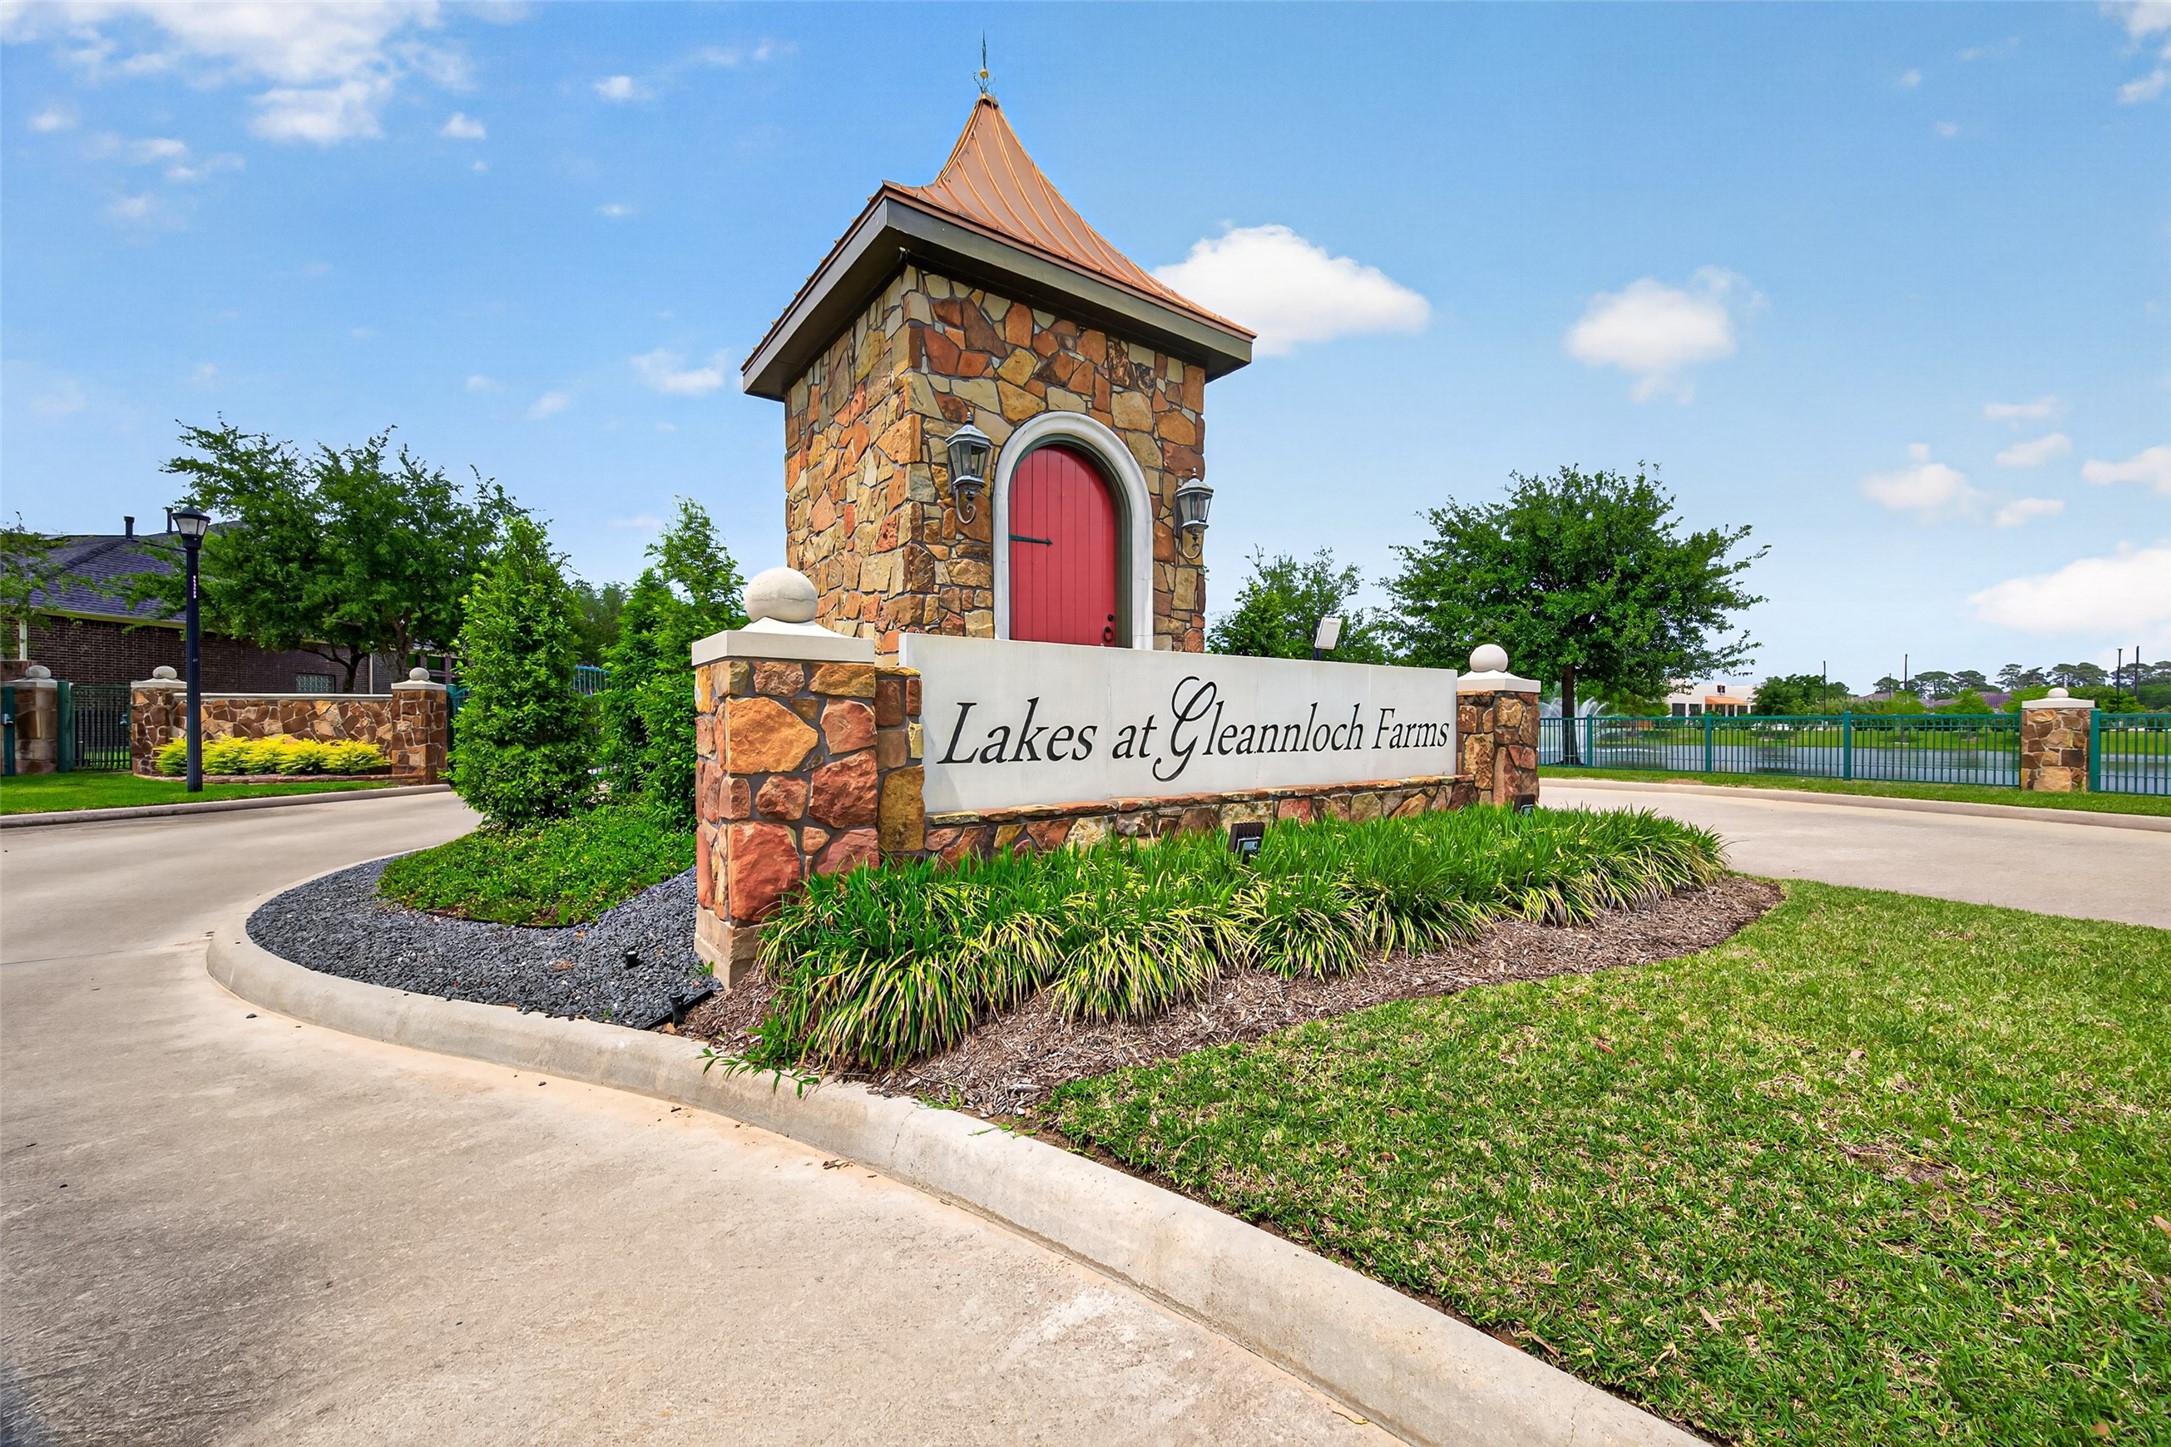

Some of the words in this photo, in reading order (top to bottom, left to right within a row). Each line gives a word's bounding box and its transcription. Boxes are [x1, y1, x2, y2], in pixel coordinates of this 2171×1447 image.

[936, 696, 1098, 765] Lakes
[1111, 714, 1158, 760] at
[1152, 675, 1364, 783] Gleannloch
[1371, 707, 1450, 750] Farms
